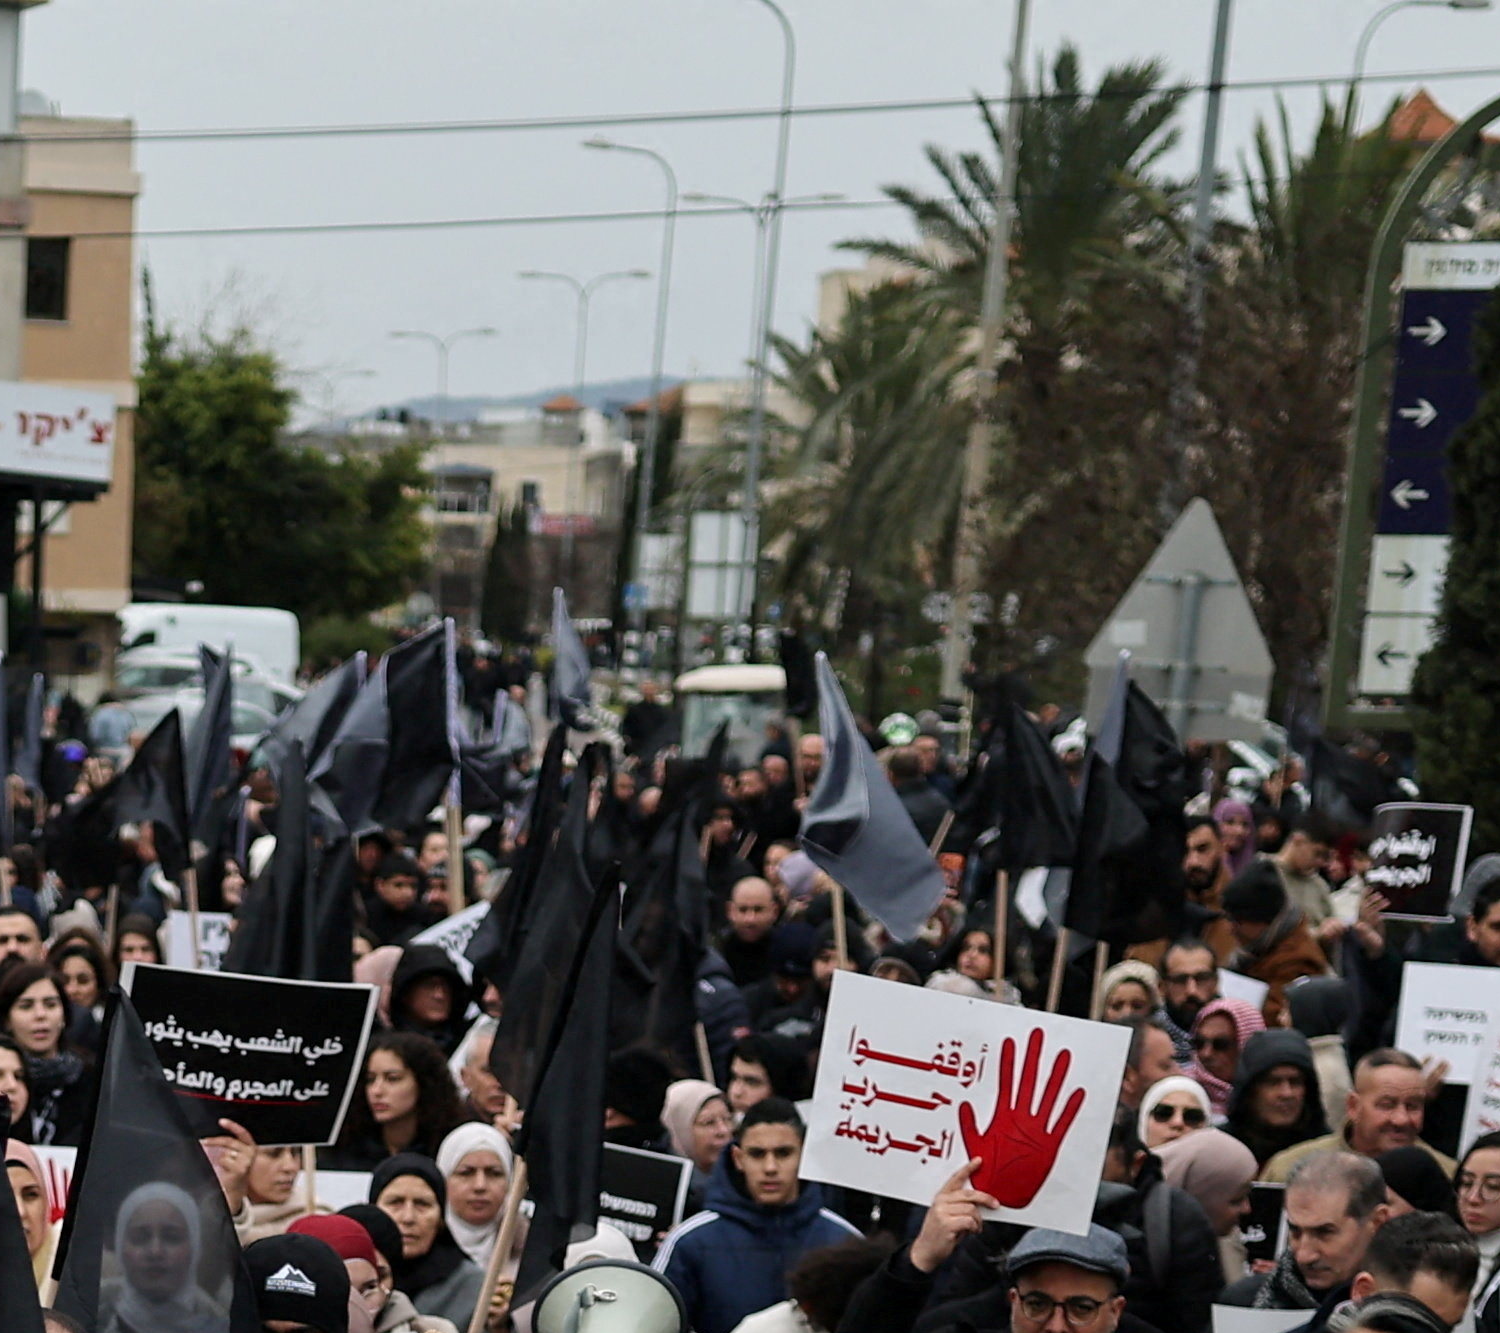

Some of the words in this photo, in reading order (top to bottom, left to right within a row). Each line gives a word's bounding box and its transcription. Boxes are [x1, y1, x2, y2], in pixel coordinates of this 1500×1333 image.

[234, 1028, 303, 1056] الشعب
[302, 1036, 345, 1067] خلي
[847, 1024, 989, 1089] أوقفوا
[225, 1078, 294, 1101] المجرم
[292, 1079, 331, 1102] على
[841, 1075, 952, 1112] حرب
[834, 1103, 955, 1165] الجريمة
